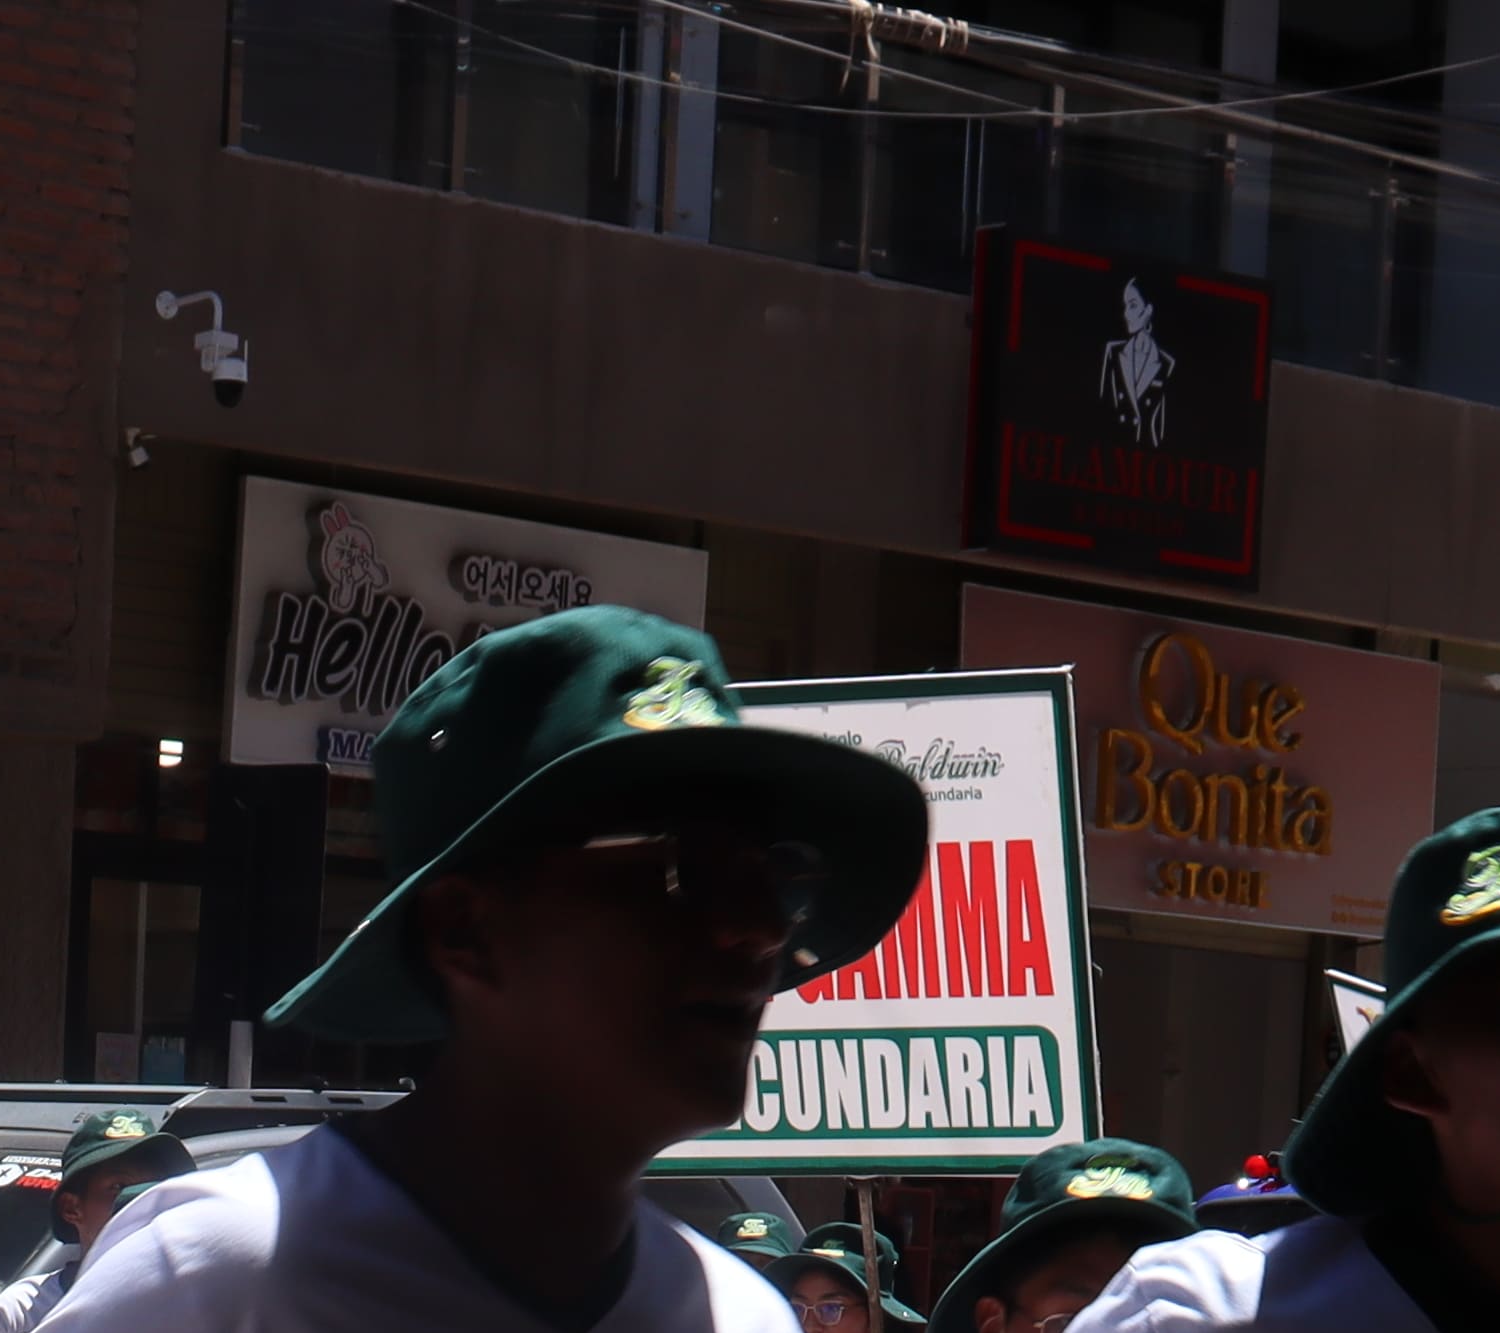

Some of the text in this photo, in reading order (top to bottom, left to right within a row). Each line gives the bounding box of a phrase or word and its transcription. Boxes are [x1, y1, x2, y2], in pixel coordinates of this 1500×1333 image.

[1017, 429, 1240, 514] GLAMOUR
[463, 555, 593, 610] 어서오세요
[262, 592, 455, 713] Hello
[1140, 632, 1305, 755] Que
[1096, 727, 1333, 855] Bonita
[728, 1035, 1056, 1133] CUNDARIA
